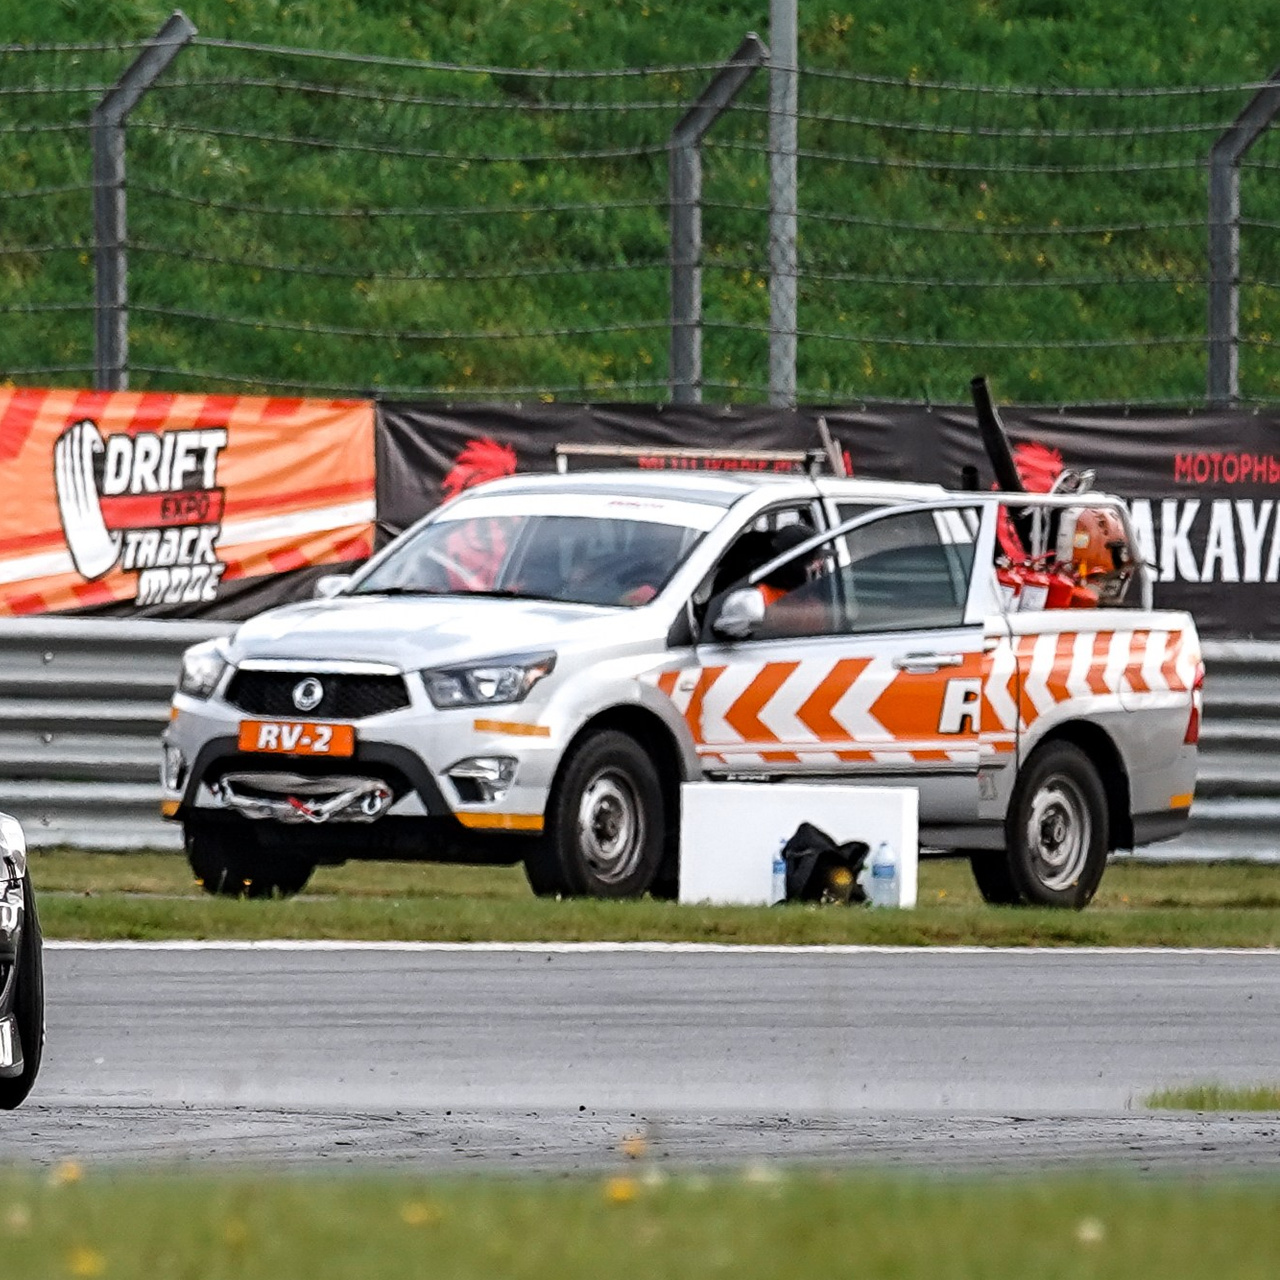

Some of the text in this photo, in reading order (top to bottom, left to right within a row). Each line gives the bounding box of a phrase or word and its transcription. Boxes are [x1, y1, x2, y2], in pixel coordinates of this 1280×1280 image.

[102, 427, 227, 495] DRIFT
[1128, 498, 1280, 583] AKAY
[256, 723, 334, 755] RV-2
